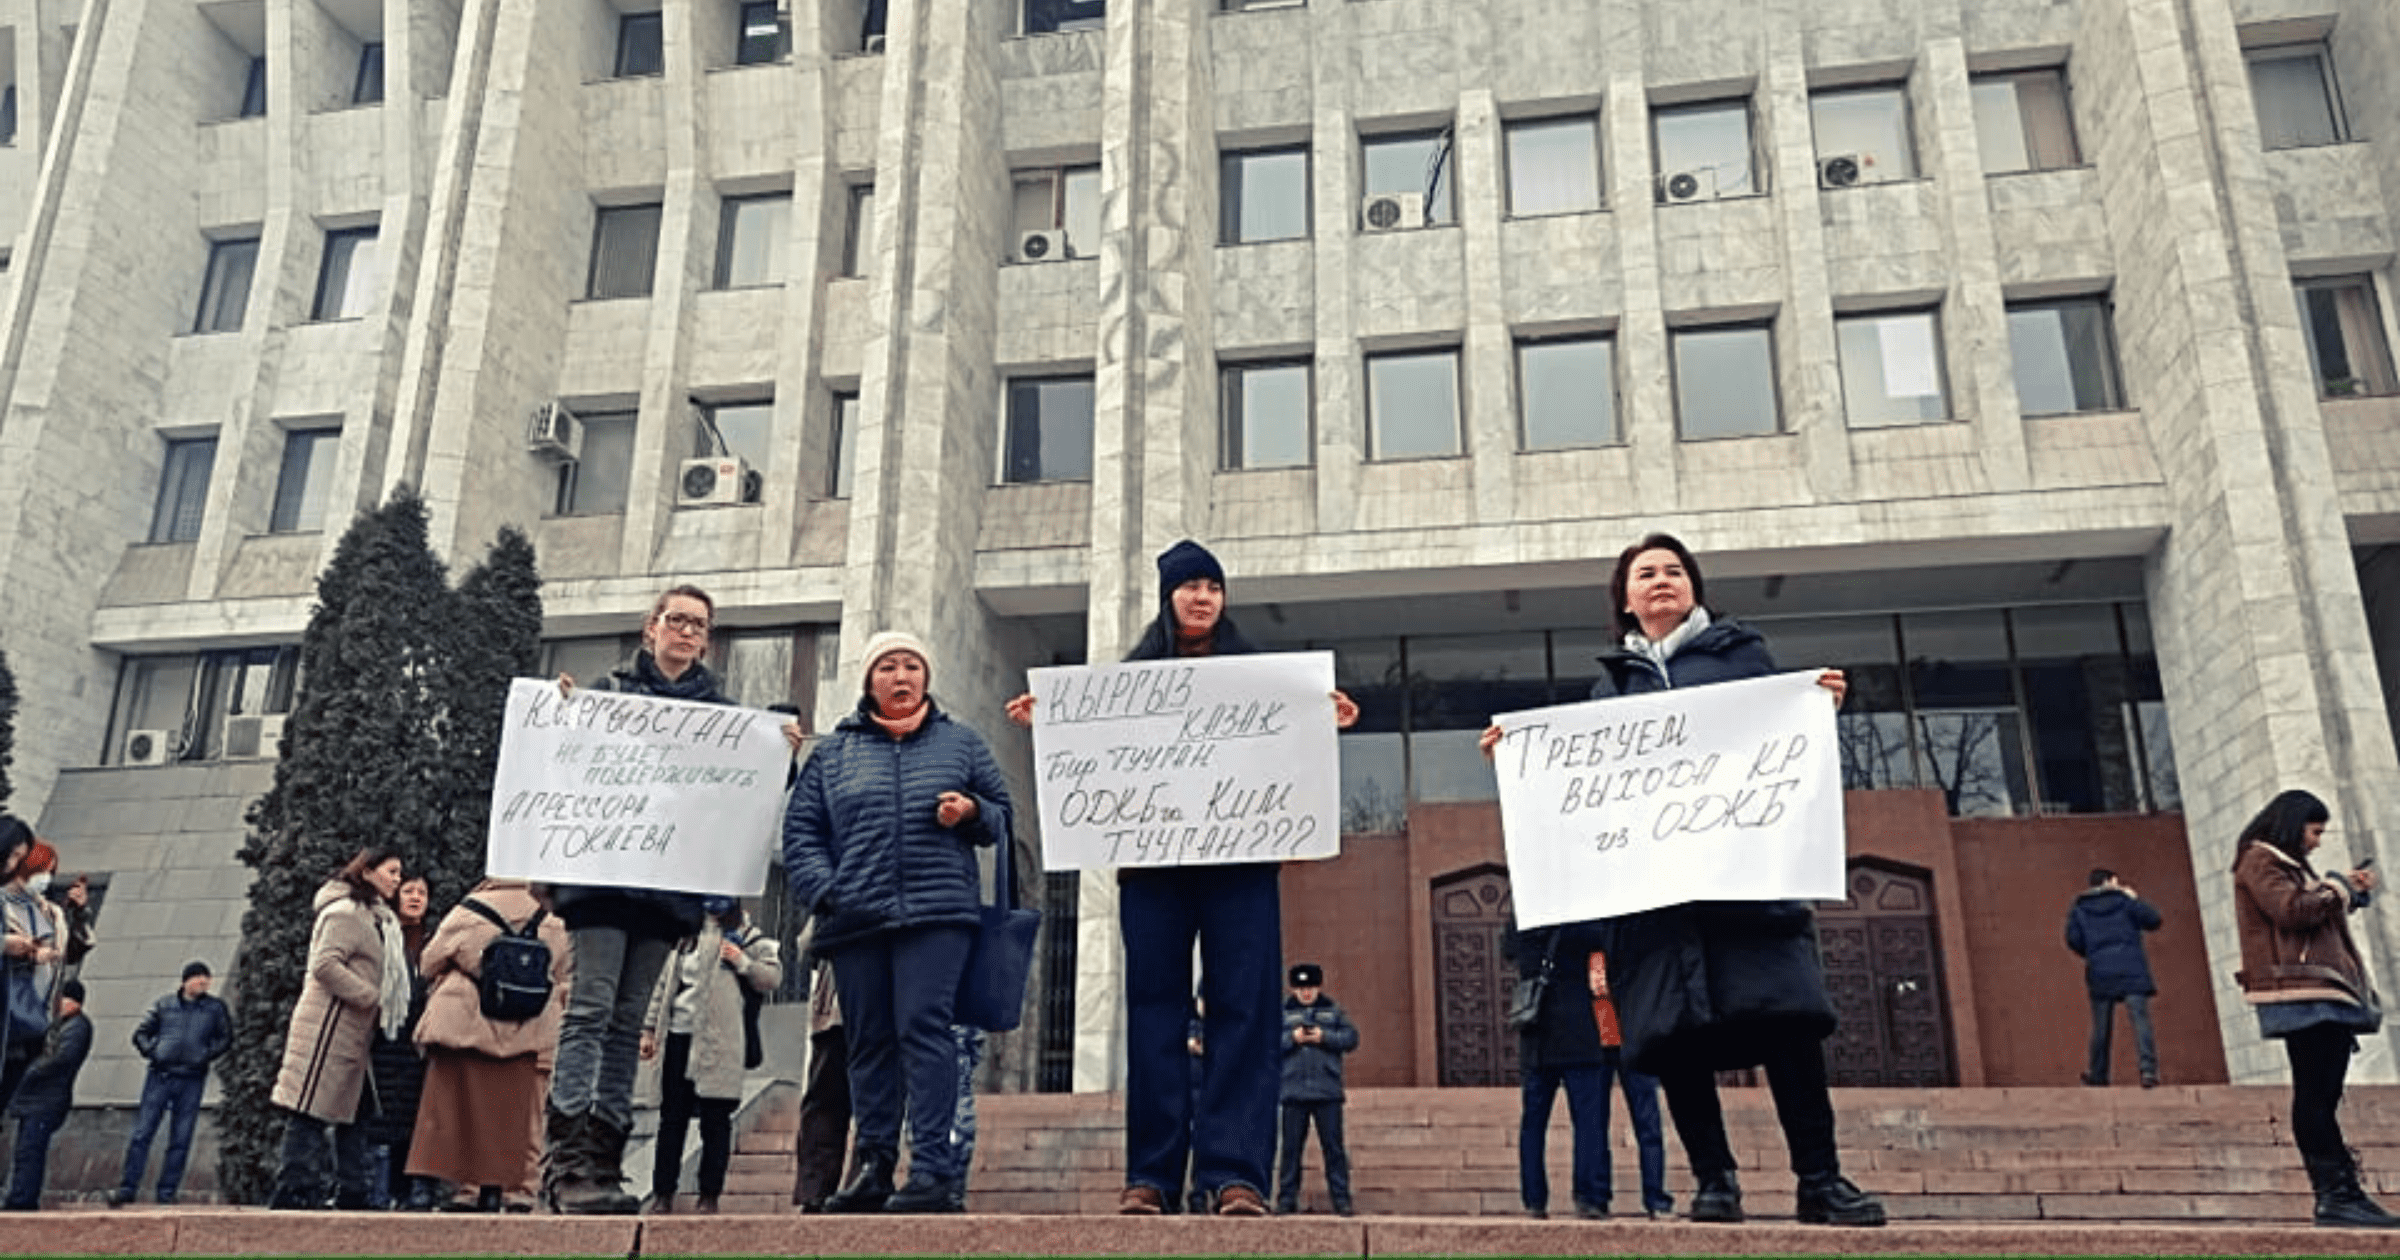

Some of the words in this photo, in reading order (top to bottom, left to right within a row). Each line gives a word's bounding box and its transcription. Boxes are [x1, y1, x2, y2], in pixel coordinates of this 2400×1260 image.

[1049, 667, 1195, 721] КЫРГЫЗ
[1178, 701, 1288, 742] КАЗАК
[556, 742, 582, 763] НЕ
[590, 743, 680, 765] БУДЕТ
[1107, 743, 1216, 771] ТУУГАН
[1504, 714, 1687, 778] ТРЕБУЕМ
[1560, 753, 1721, 815] ВЫХОДА
[1747, 734, 1808, 781] КР
[501, 790, 650, 823] АГРЕССОРА
[1652, 778, 1800, 841] ОДКБ
[539, 823, 677, 858] ТОКАЕВА
[1103, 815, 1317, 864] ТУУГАН???
